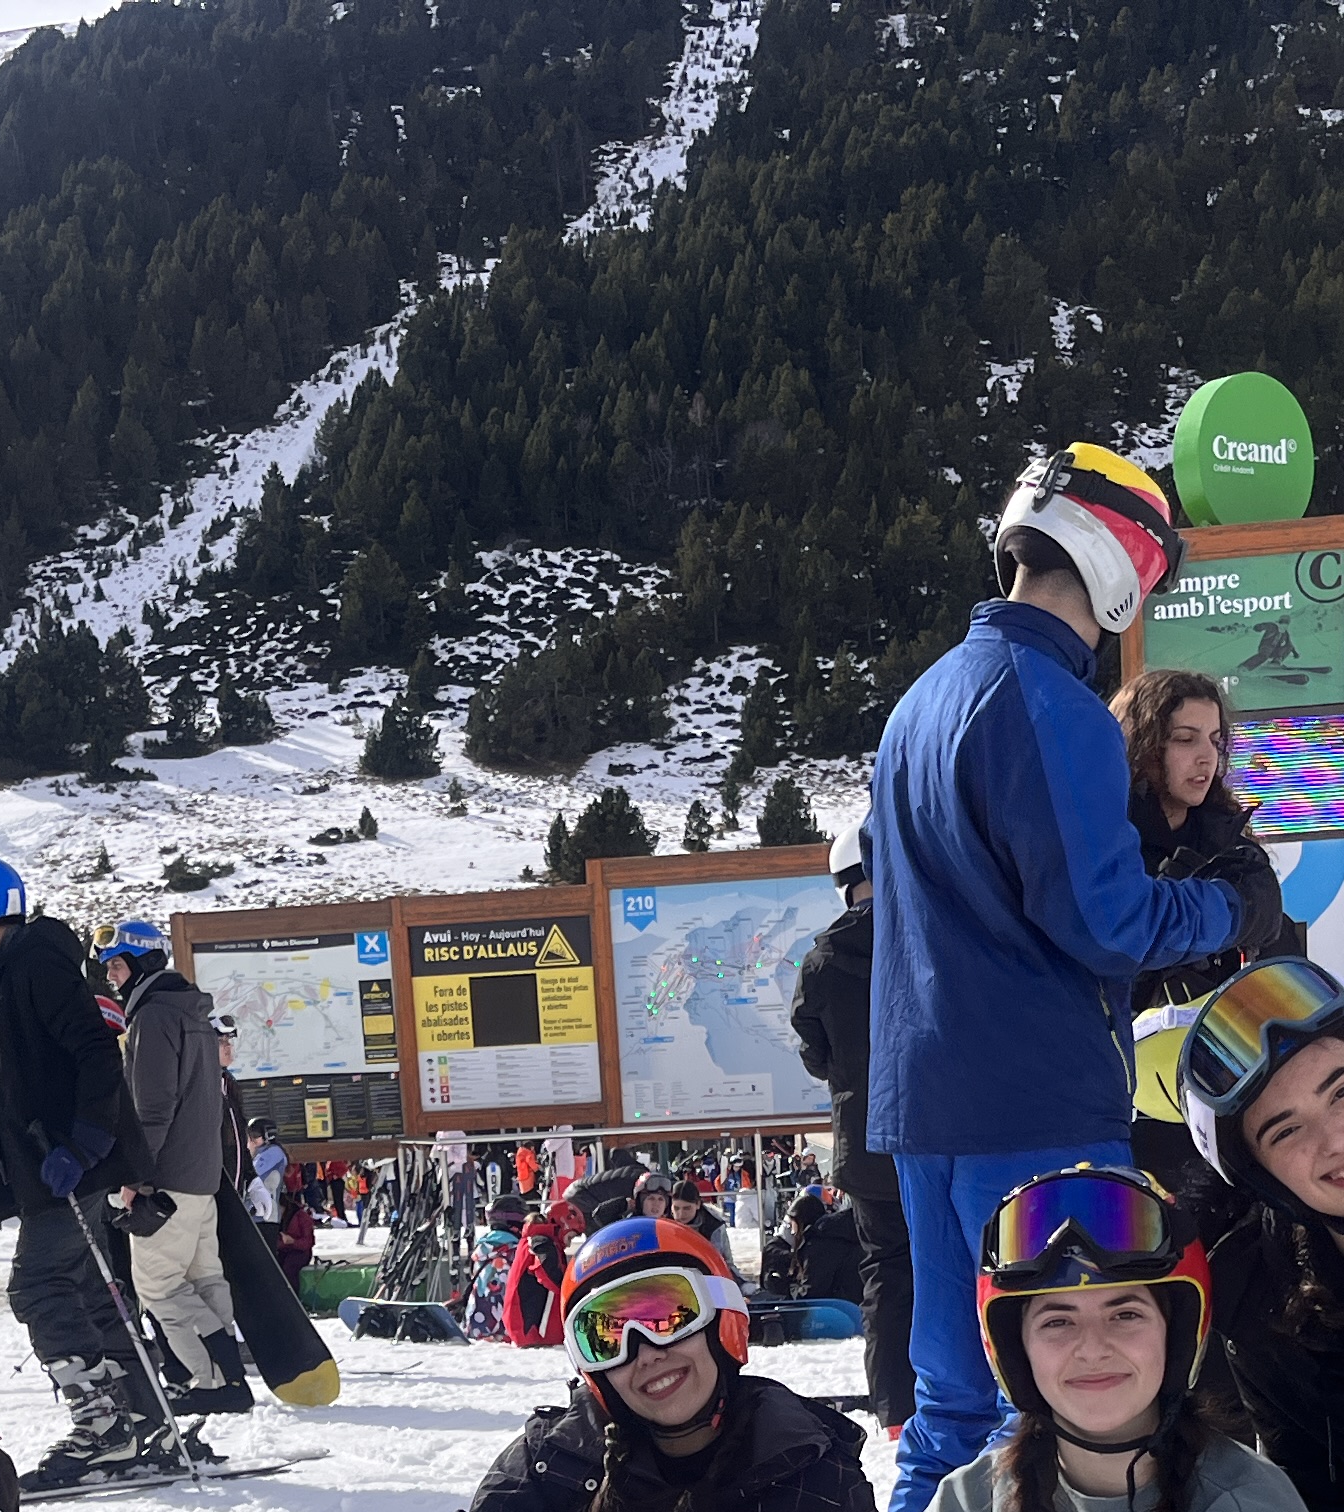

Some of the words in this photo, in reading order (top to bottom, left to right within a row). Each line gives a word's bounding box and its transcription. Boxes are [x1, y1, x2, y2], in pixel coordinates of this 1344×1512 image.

[1170, 573, 1240, 597] mpre
[1154, 597, 1204, 620] amb
[625, 896, 654, 911] 210
[423, 930, 452, 944] Avui
[461, 931, 480, 943] Hoy
[489, 926, 545, 941] Aujourd'hui
[424, 947, 460, 962] RISC
[463, 941, 538, 960] D'ALLAUS
[434, 986, 454, 997] Fora
[456, 985, 468, 997] de
[425, 1001, 439, 1013] les
[441, 1000, 468, 1015] pistes
[421, 1016, 470, 1028] abalisades
[437, 1030, 470, 1042] obertes
